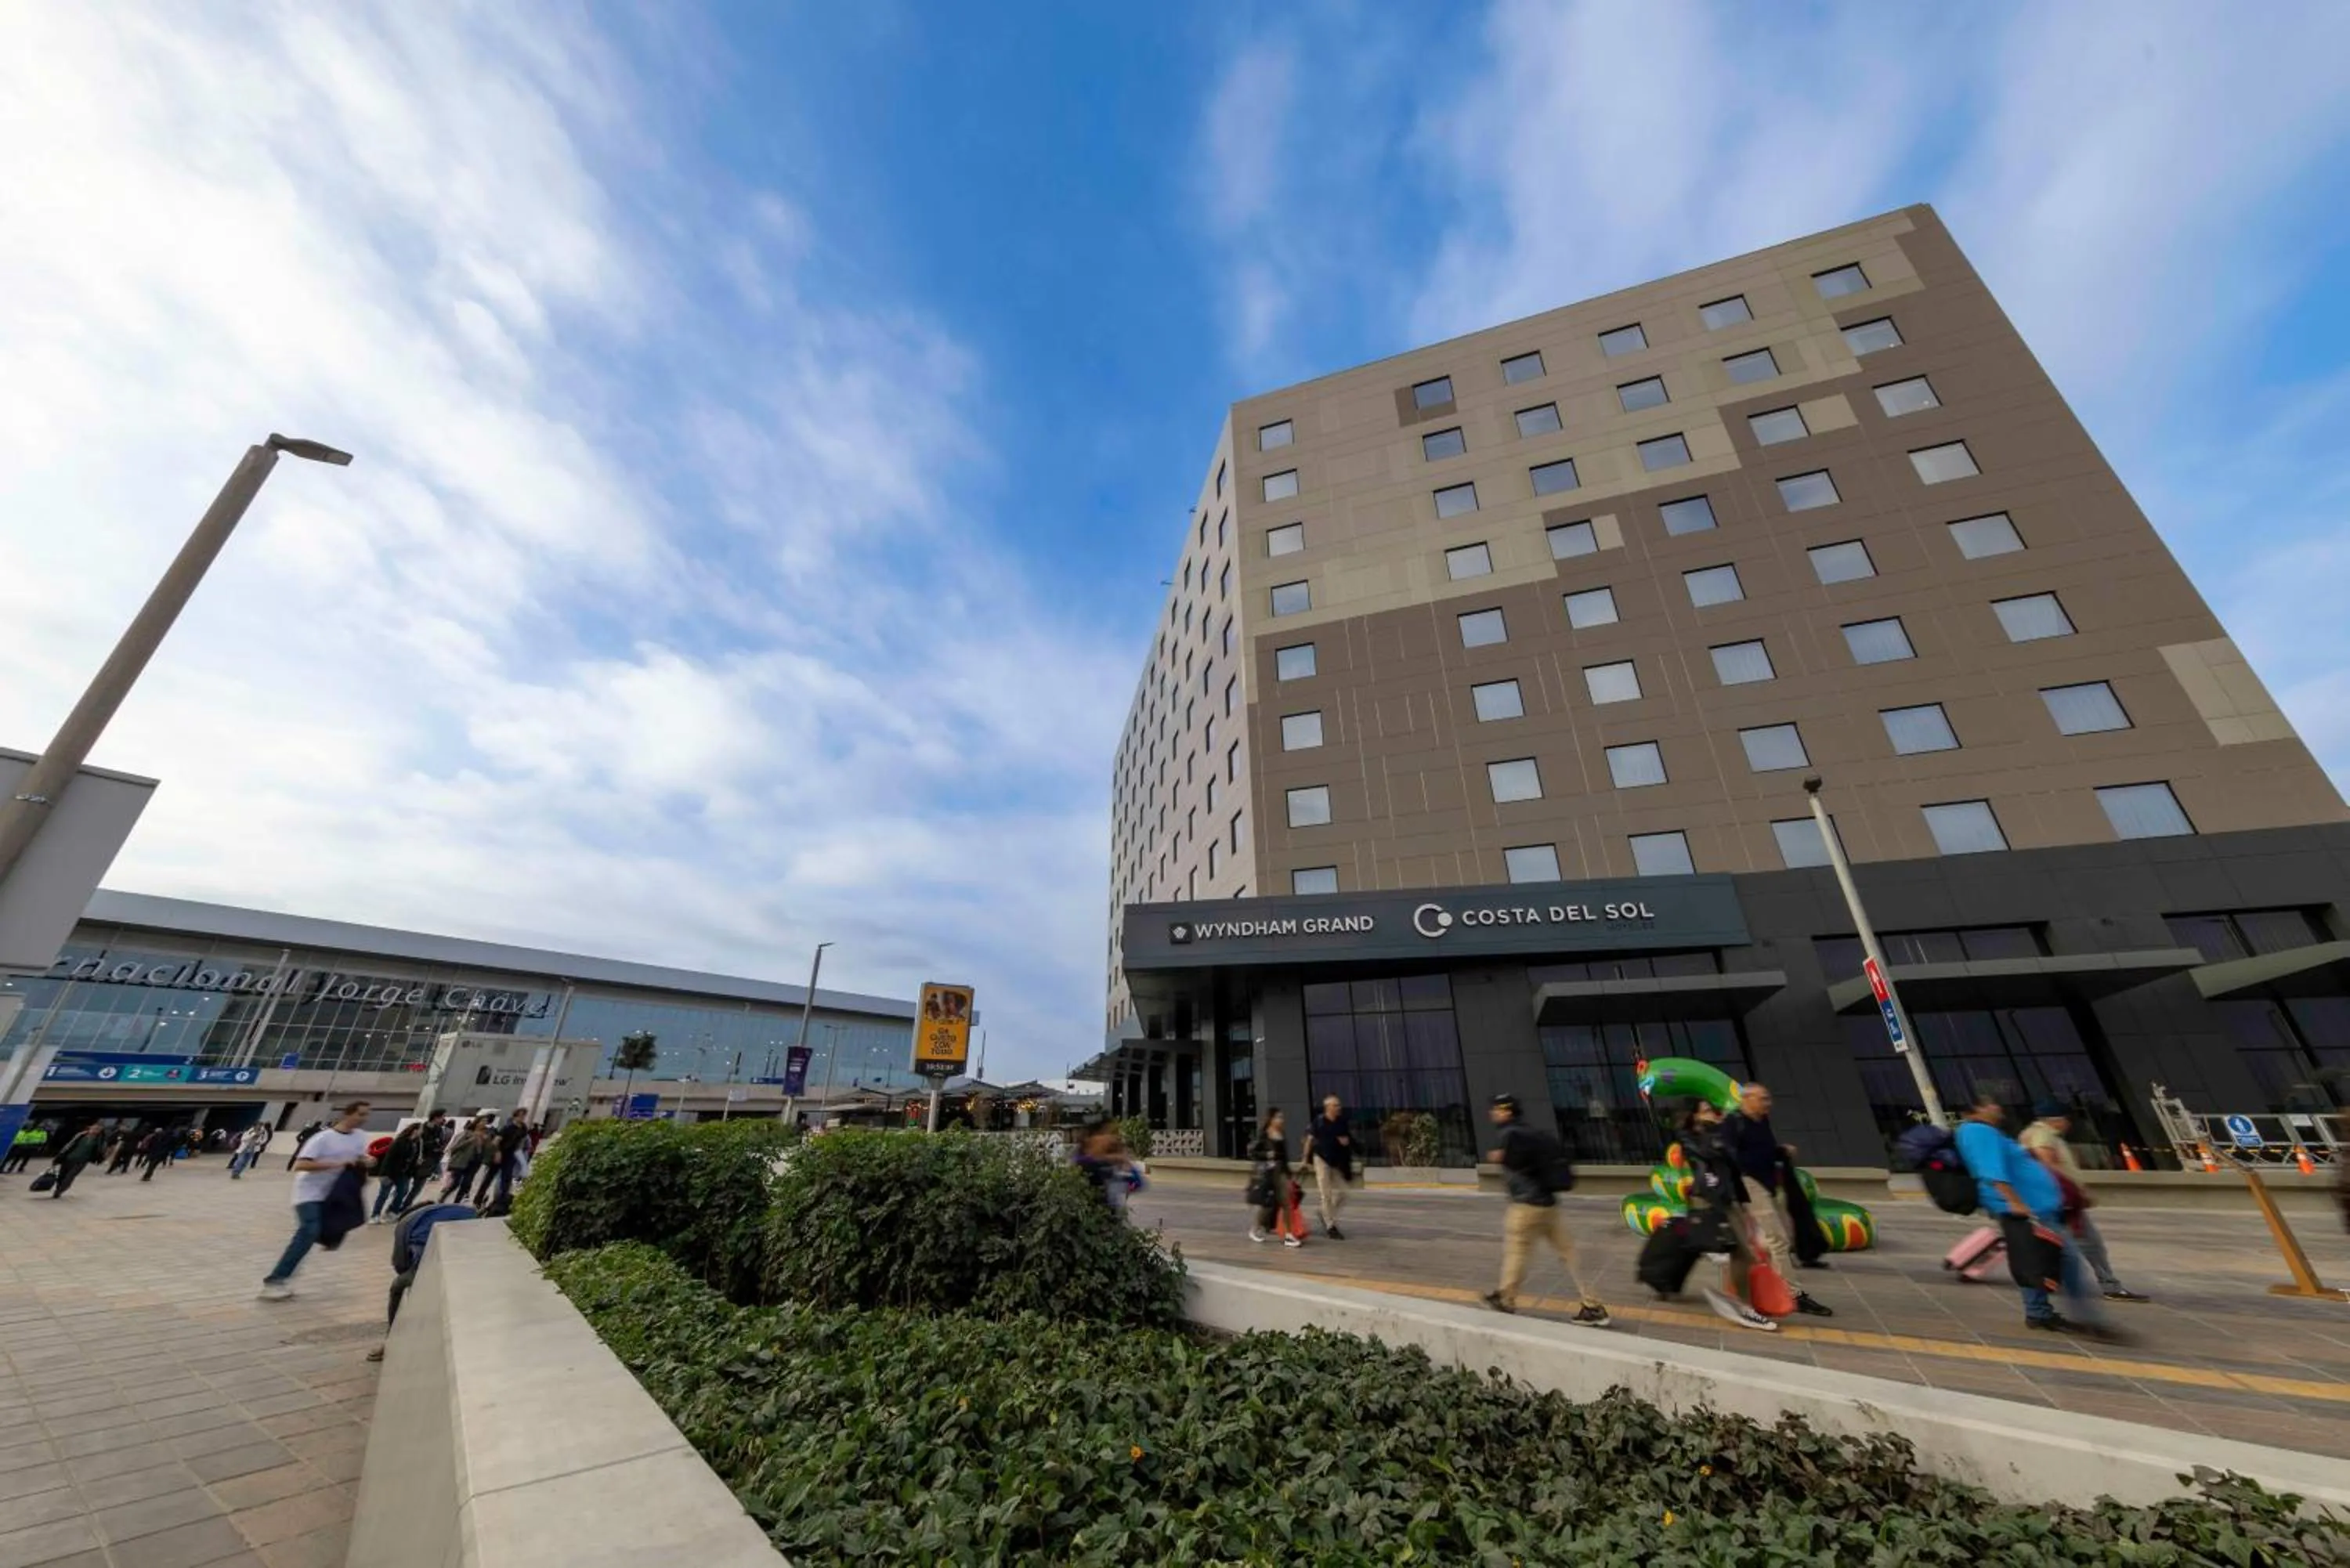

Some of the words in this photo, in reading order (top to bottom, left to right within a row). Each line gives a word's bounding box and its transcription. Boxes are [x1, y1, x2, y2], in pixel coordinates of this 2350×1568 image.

[1462, 908, 1542, 926] COSTA
[1549, 905, 1597, 922] DEL
[1605, 901, 1655, 919] SOL
[1195, 918, 1297, 938] WYNDHAM
[1303, 915, 1375, 934] GRAND
[314, 975, 425, 1009] Jorge
[128, 1068, 142, 1078] 2
